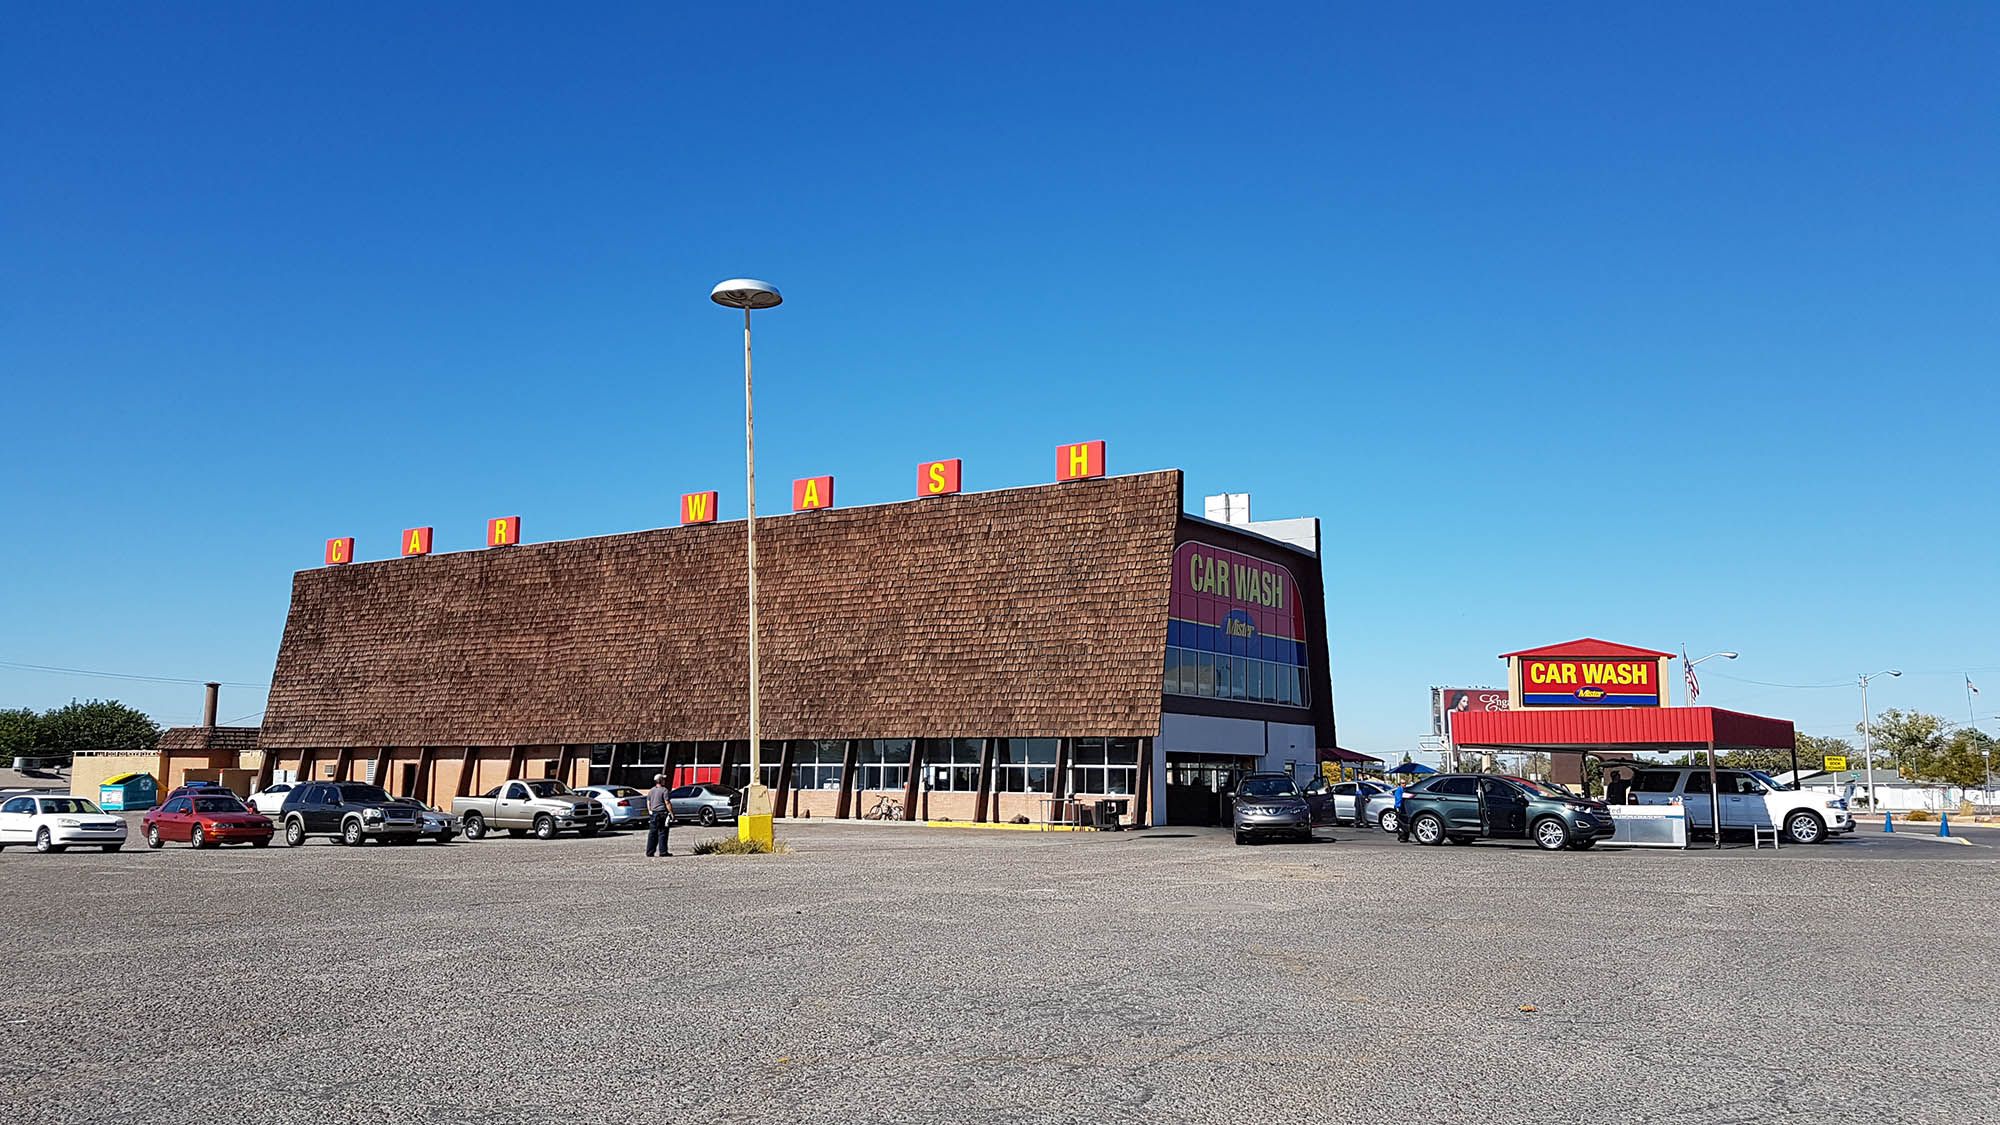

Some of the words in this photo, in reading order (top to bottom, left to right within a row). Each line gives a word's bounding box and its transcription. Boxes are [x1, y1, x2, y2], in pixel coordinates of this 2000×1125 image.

[1190, 553, 1230, 598] CAR
[1233, 563, 1283, 609] WASH
[1226, 618, 1255, 638] Mister
[1530, 662, 1577, 684] CAR
[1581, 663, 1648, 685] WASH
[1578, 689, 1604, 698] Mister
